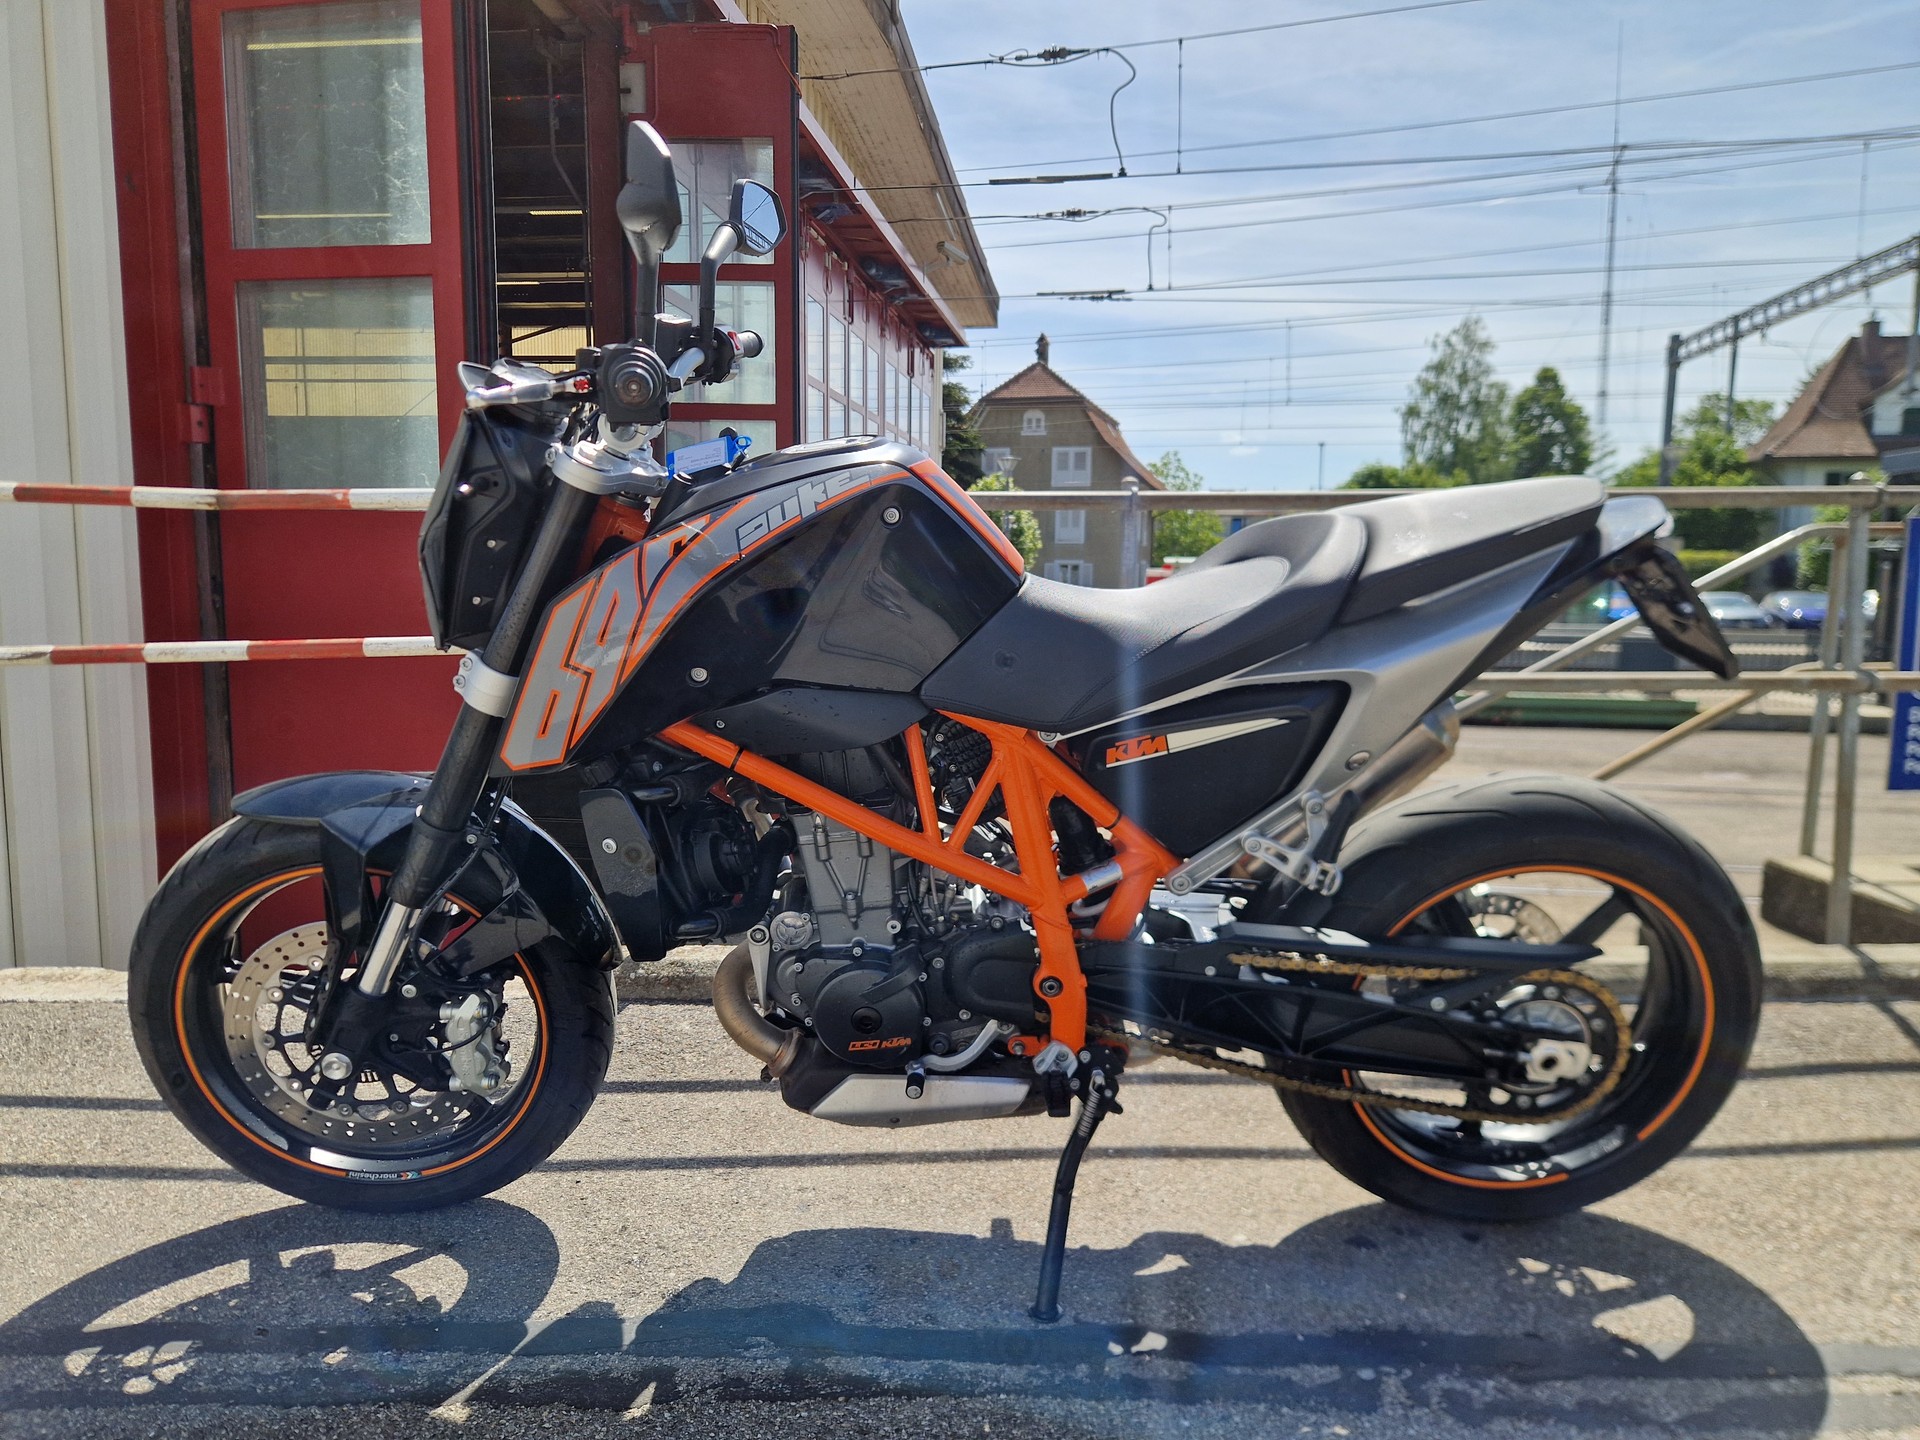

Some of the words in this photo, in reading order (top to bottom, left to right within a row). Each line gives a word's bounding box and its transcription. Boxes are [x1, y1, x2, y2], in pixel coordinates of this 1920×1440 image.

[1106, 735, 1167, 764] KTM
[881, 1037, 911, 1048] KTM
[348, 1171, 398, 1181] marchesini
